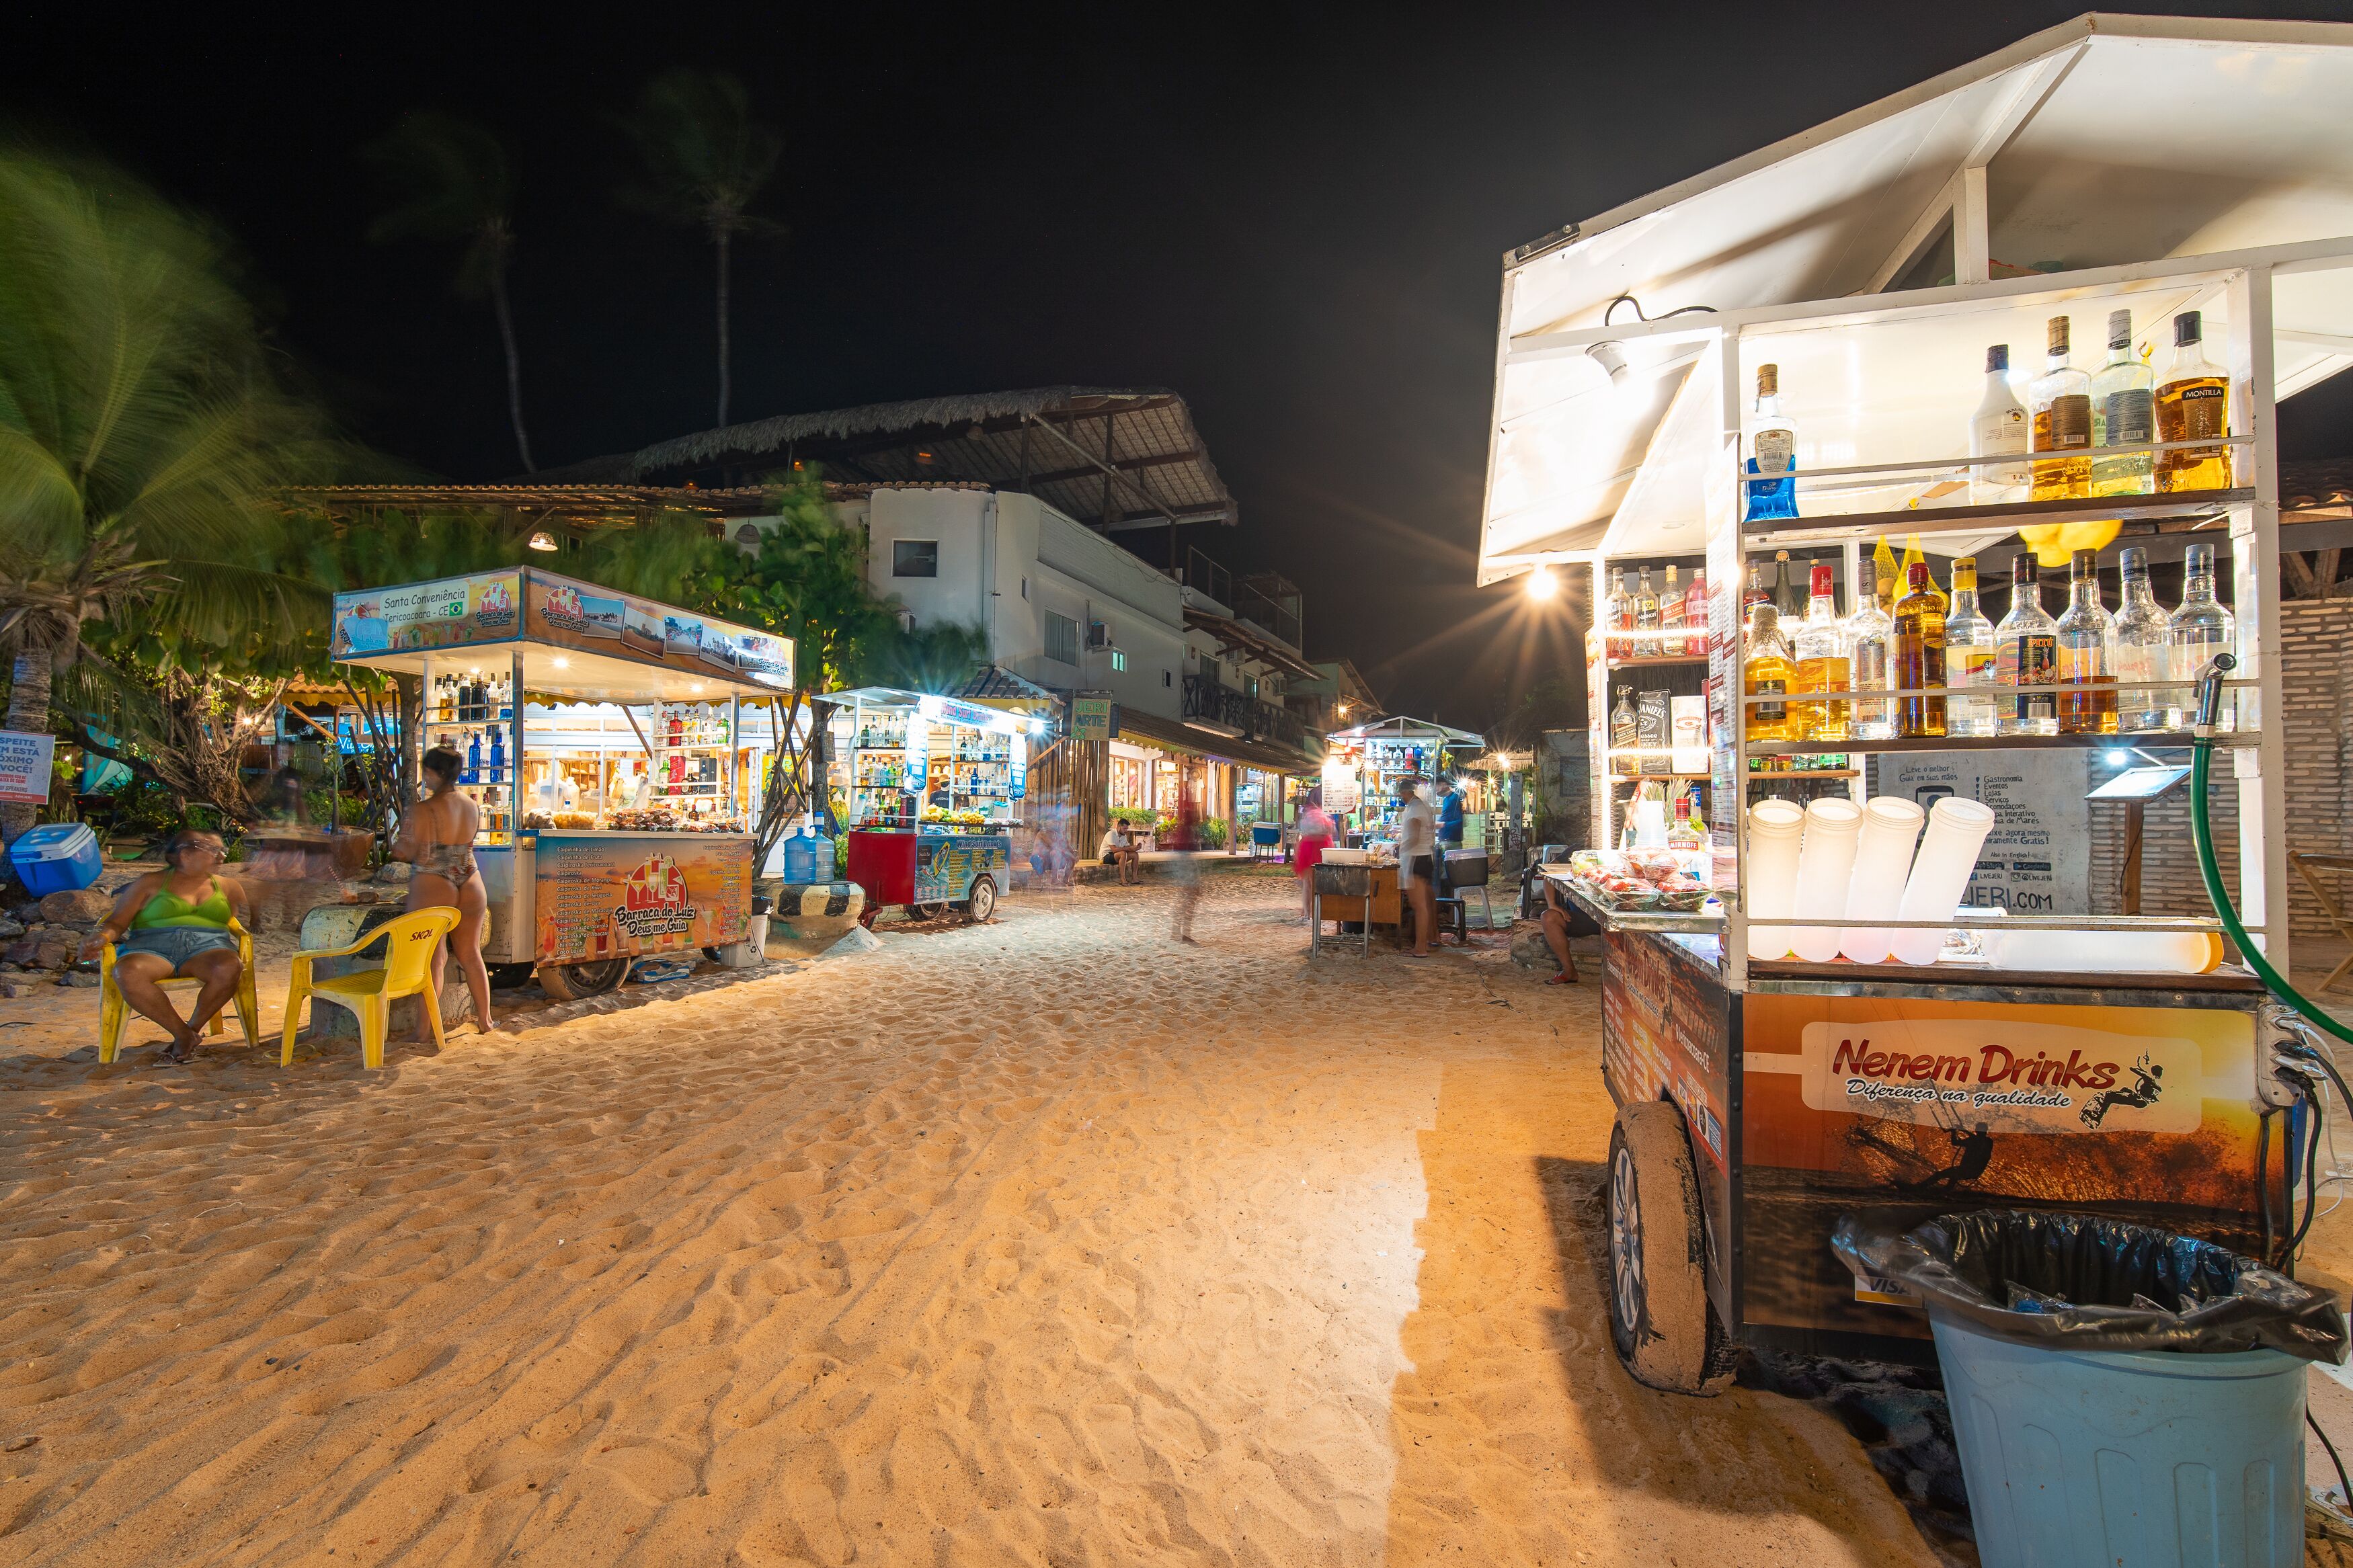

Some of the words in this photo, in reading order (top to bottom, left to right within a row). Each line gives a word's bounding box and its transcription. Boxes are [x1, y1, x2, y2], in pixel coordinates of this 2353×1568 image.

[2186, 388, 2222, 399] MONTILLA
[385, 597, 409, 609] Santa
[411, 589, 465, 605] Conveniência
[384, 612, 431, 623] Jericoacoara
[438, 605, 448, 616] CE
[1663, 608, 1672, 616] Red
[1672, 604, 1685, 613] Label
[543, 608, 567, 620] Barraca
[568, 614, 575, 622] do
[575, 615, 589, 626] Luiz
[548, 616, 563, 627] Deus
[563, 620, 571, 628] me
[571, 622, 584, 632] Guia
[2028, 636, 2054, 647] PITÚ
[941, 702, 957, 717] Wind
[1076, 701, 1108, 714] JERI
[1074, 714, 1107, 727] ARTE
[1626, 728, 1637, 736] LABEL
[13, 747, 40, 756] ESTÁ
[1, 764, 32, 774] VOCÊ!
[1906, 766, 1923, 774] Leve
[1929, 765, 1950, 773] melhor
[1899, 774, 1914, 782] Guia
[1941, 772, 1958, 781] mãos
[1984, 775, 2023, 783] Gastronomia
[1984, 790, 2001, 798] Lojas
[1985, 796, 2009, 804] Serviços
[2016, 815, 2040, 825] Marés
[2005, 830, 2026, 838] agora
[957, 840, 971, 848] Wind
[971, 840, 984, 848] Surf
[2009, 851, 2030, 859] English!
[2021, 874, 2052, 882] @LIVEJERI
[614, 905, 660, 924] Barraca
[661, 902, 674, 918] do
[674, 901, 696, 918] Luiz
[627, 919, 652, 936] Deus
[653, 923, 667, 934] me
[667, 917, 687, 932] Guia
[409, 928, 434, 942] SKOL
[1832, 1038, 1972, 1082] Nenem
[1977, 1044, 2120, 1090] Drinks
[1846, 1077, 1938, 1102] Diferença
[1942, 1089, 1968, 1102] na
[1972, 1089, 2071, 1108] qualidade
[1869, 1278, 1912, 1296] VISA
